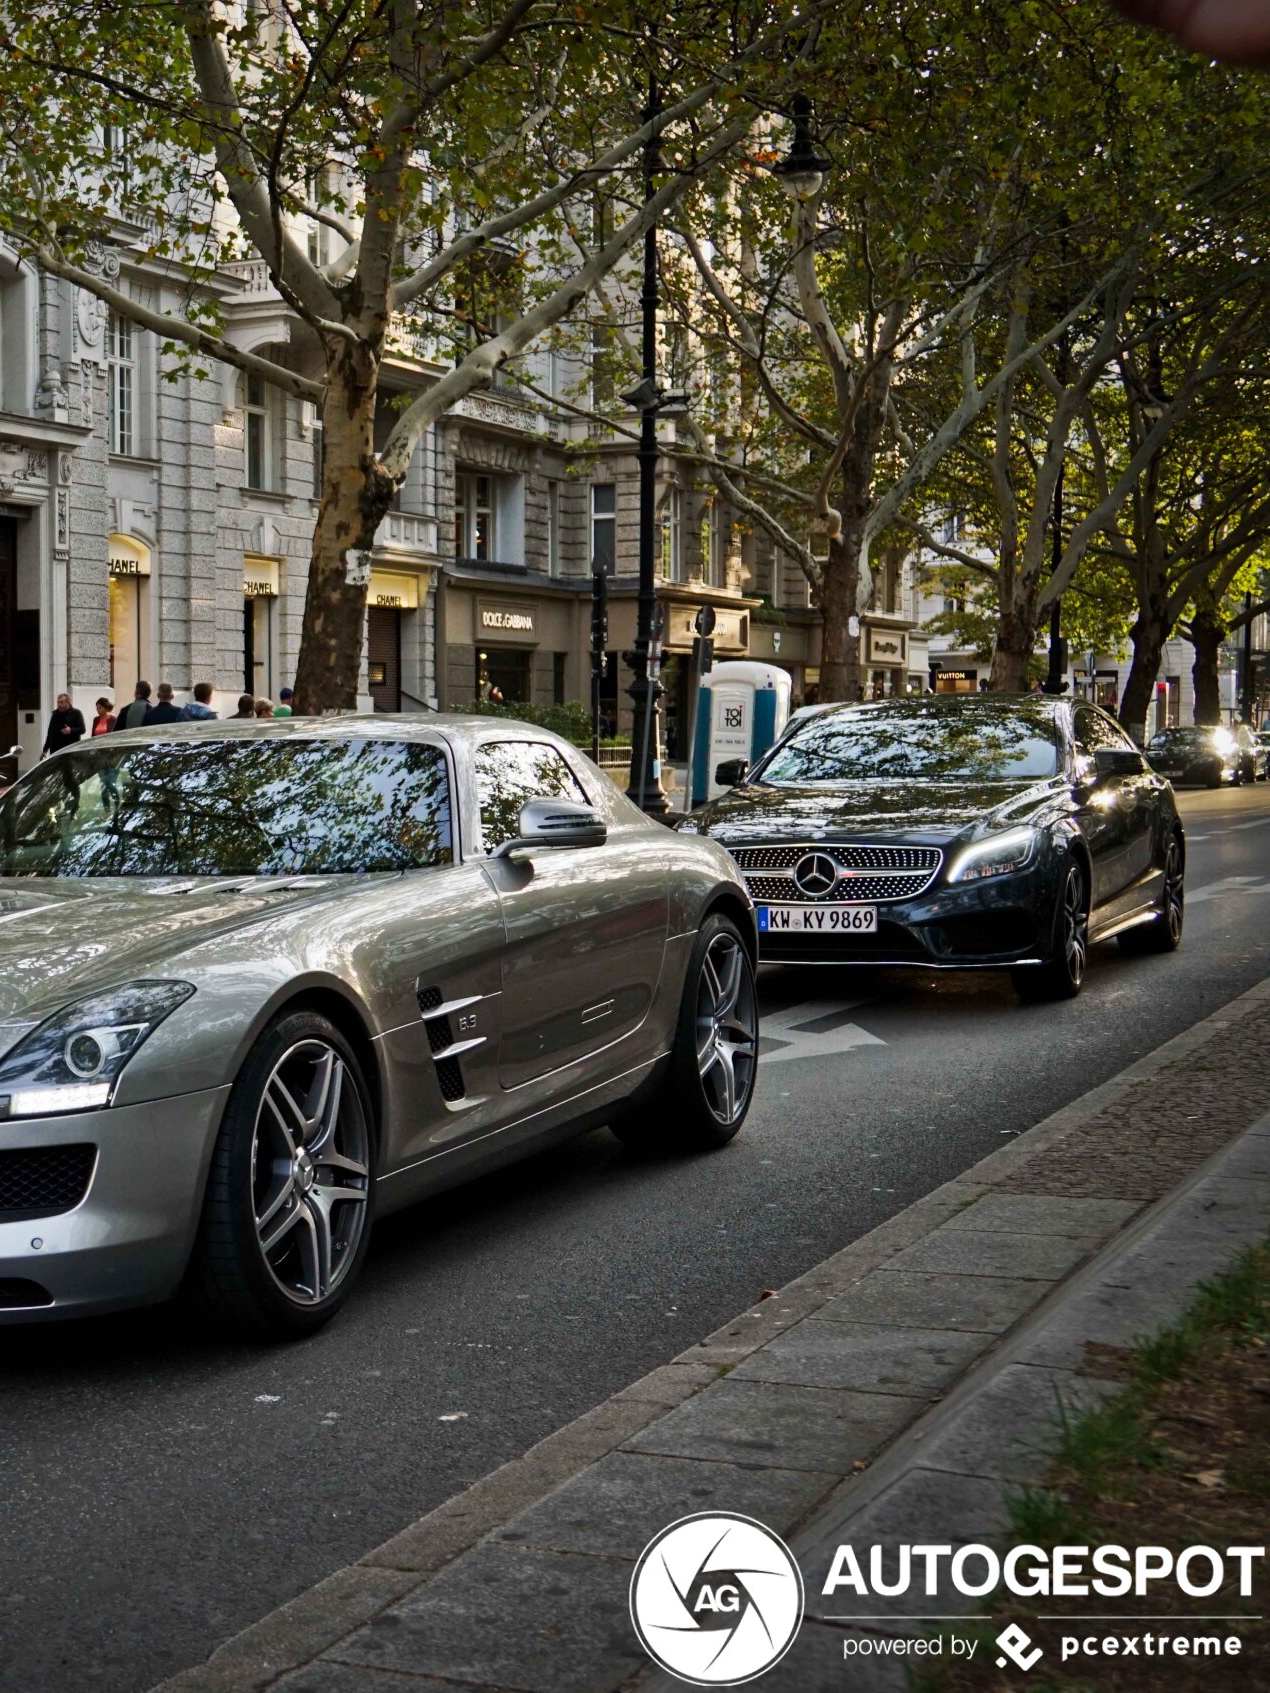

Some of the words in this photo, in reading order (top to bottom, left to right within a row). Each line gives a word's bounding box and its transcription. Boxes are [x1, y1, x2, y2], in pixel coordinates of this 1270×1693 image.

[108, 558, 142, 574] HANEL
[376, 594, 402, 606] CHANEL
[937, 672, 966, 680] VUITTON
[770, 911, 790, 929] KW
[803, 911, 825, 929] KY
[830, 911, 874, 929] 9869
